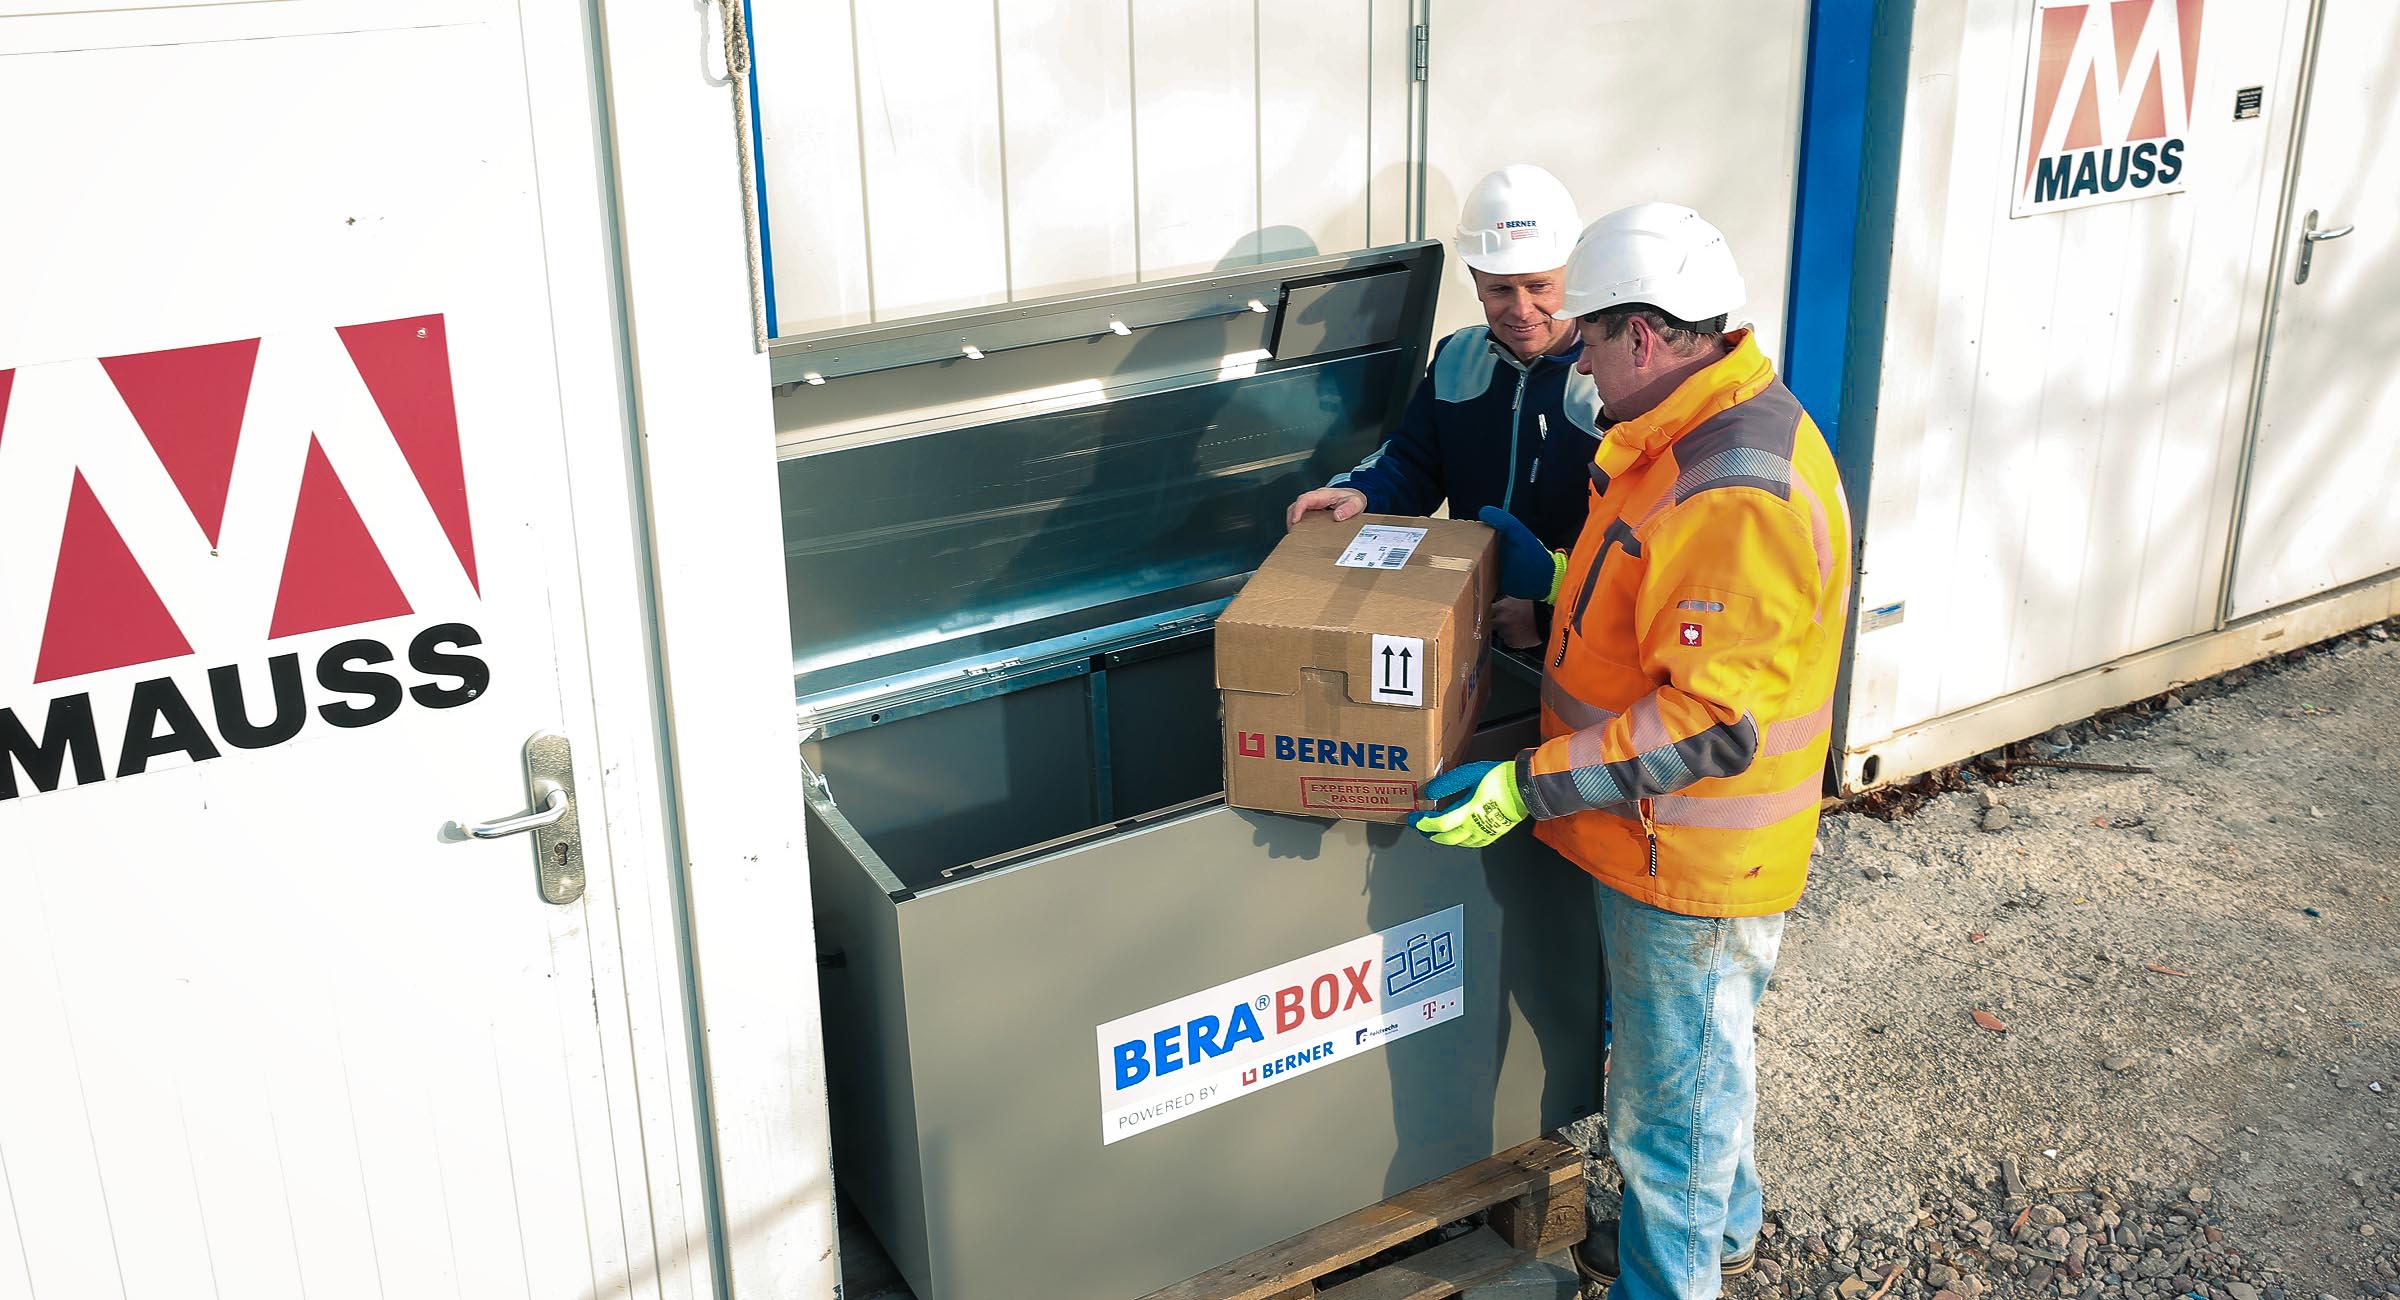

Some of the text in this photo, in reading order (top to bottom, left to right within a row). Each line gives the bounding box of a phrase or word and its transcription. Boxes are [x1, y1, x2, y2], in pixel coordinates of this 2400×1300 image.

[2034, 139, 2185, 203] MAUSS
[1505, 220, 1537, 228] BERNER
[0, 622, 490, 800] MAUSS
[1275, 735, 1411, 772] BERNER
[1311, 784, 1408, 796] EXPERTS WITH
[1331, 794, 1390, 805] PASSION
[1275, 959, 1374, 1035] BOX
[1119, 1093, 1195, 1130] POWERED
[1199, 1083, 1219, 1103] BY
[1262, 1041, 1335, 1080] BERNER
